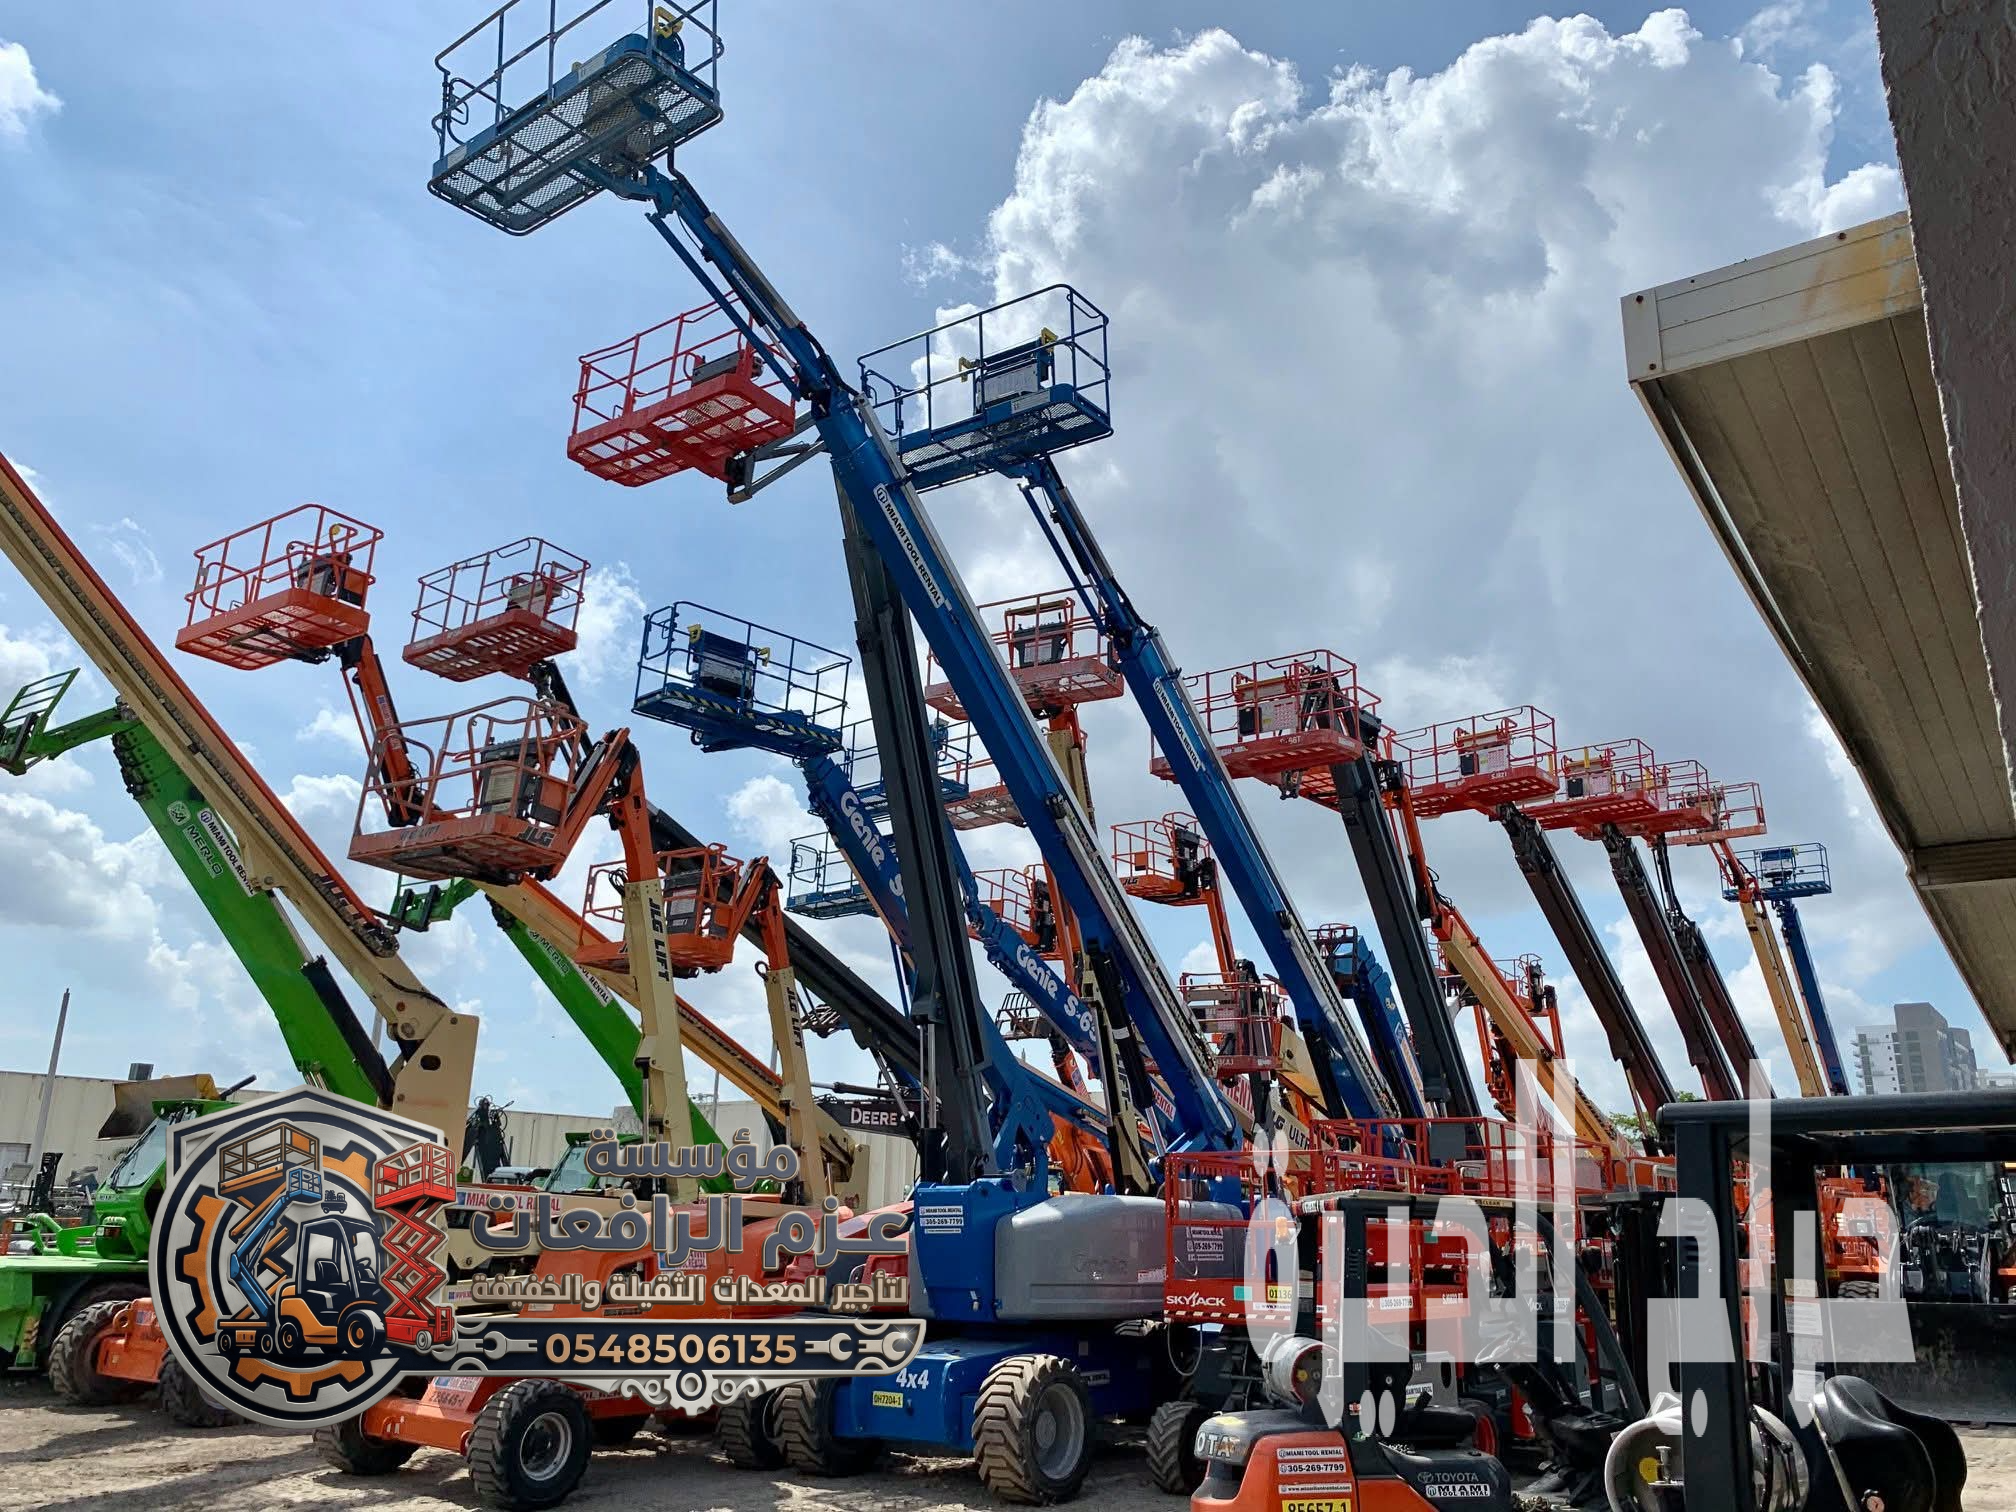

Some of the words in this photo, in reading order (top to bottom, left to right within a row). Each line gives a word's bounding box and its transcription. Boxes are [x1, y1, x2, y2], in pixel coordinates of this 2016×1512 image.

[885, 503, 906, 538] MIAMI
[904, 536, 920, 566] TOOL
[918, 564, 942, 605] RENTAL
[1173, 717, 1185, 738] TOOL
[208, 822, 226, 848] MIAMI
[223, 846, 239, 867] TOOL
[517, 826, 555, 848] JLG
[841, 791, 885, 870] Genie
[187, 825, 223, 875] MERLO
[648, 897, 664, 938] JLG
[540, 936, 570, 975] MERLO
[654, 938, 671, 983] LIFT
[1016, 943, 1059, 1000] Genie
[588, 975, 609, 1003] RENTAL
[786, 986, 798, 1017] JLG
[791, 1017, 804, 1049] LIFT
[850, 1107, 898, 1126] DEERE
[1289, 1124, 1311, 1151] ULTR
[1166, 1291, 1226, 1307] SKYJACK
[896, 1367, 930, 1390] 4x4
[1194, 1431, 1232, 1458] OTA
[1287, 1464, 1345, 1473] 305-269-7799
[1435, 1472, 1480, 1482] TOYOTA
